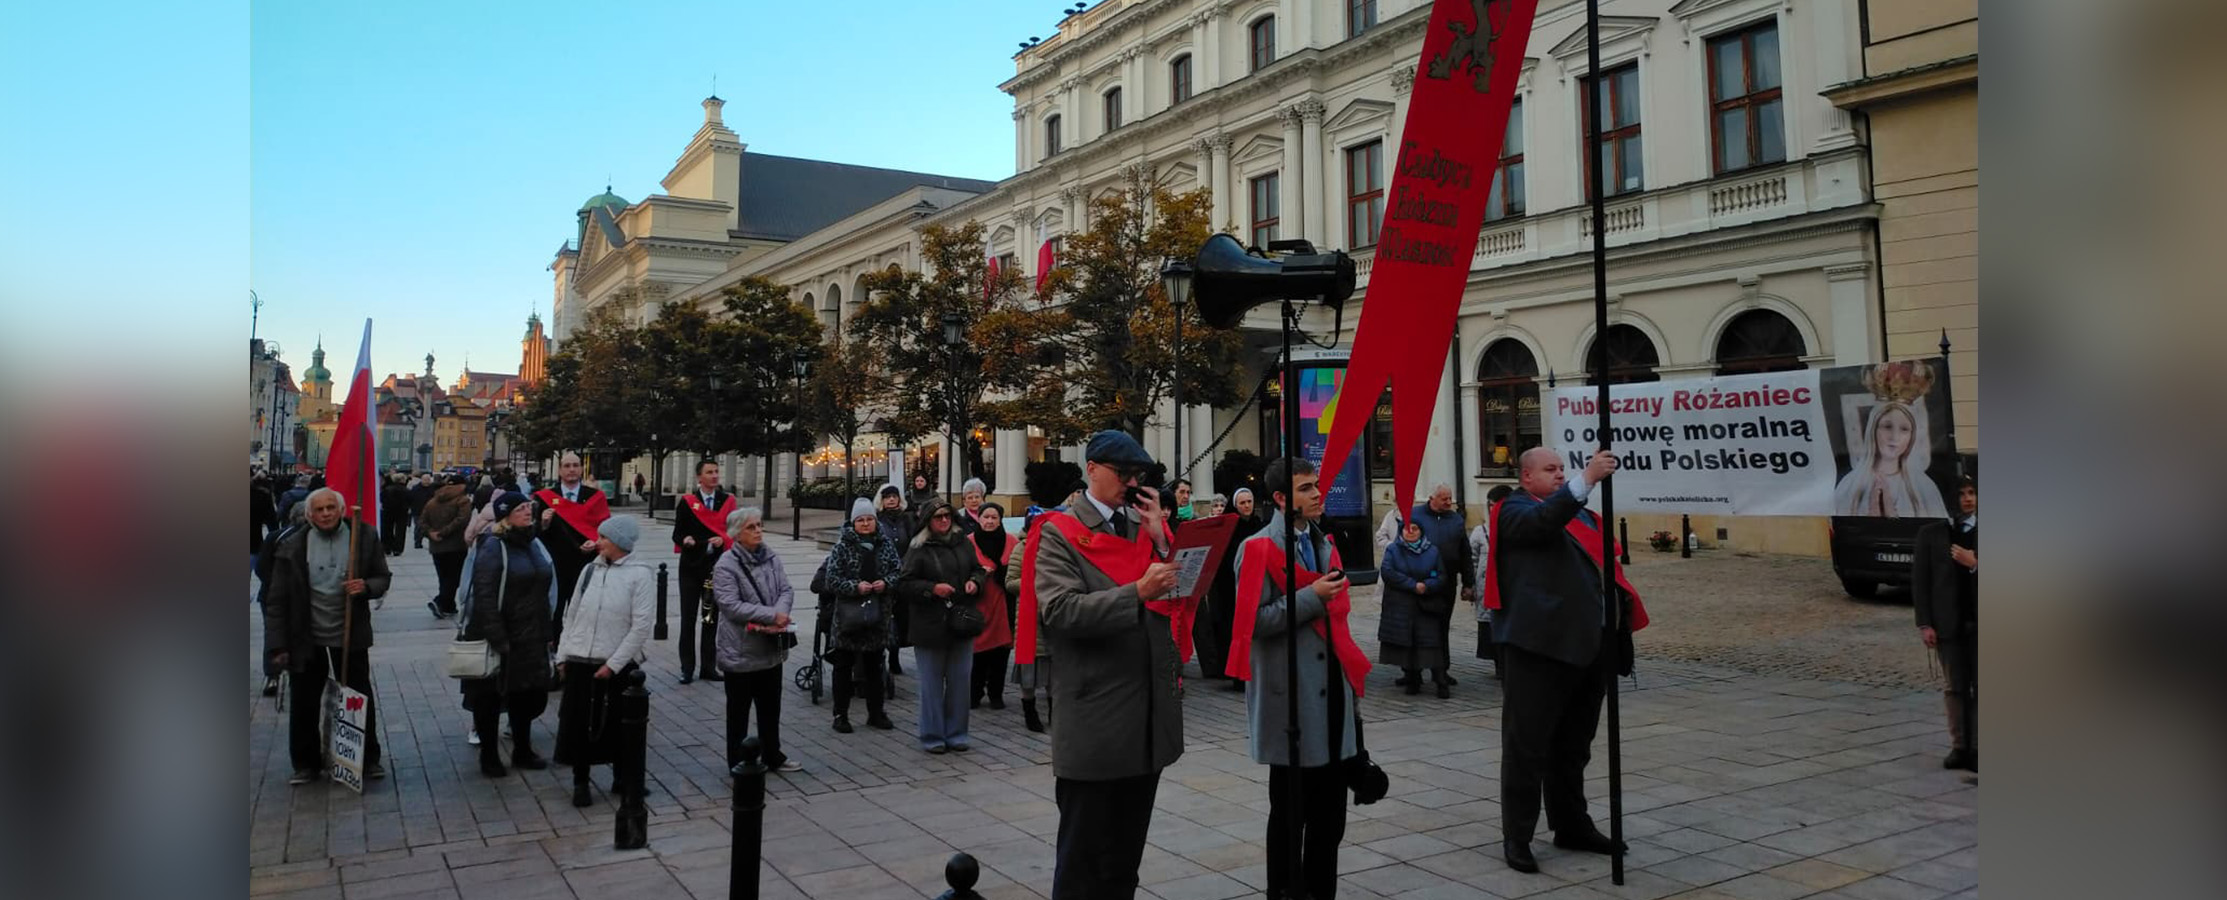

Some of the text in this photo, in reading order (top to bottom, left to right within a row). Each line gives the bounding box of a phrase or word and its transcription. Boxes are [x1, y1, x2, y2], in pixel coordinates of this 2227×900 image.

[1557, 396, 1664, 418] Publczny
[1673, 384, 1812, 411] Różaniec
[1564, 428, 1575, 442] o
[1683, 416, 1813, 442] moralną
[1569, 448, 1810, 474] Nodu Polskiego
